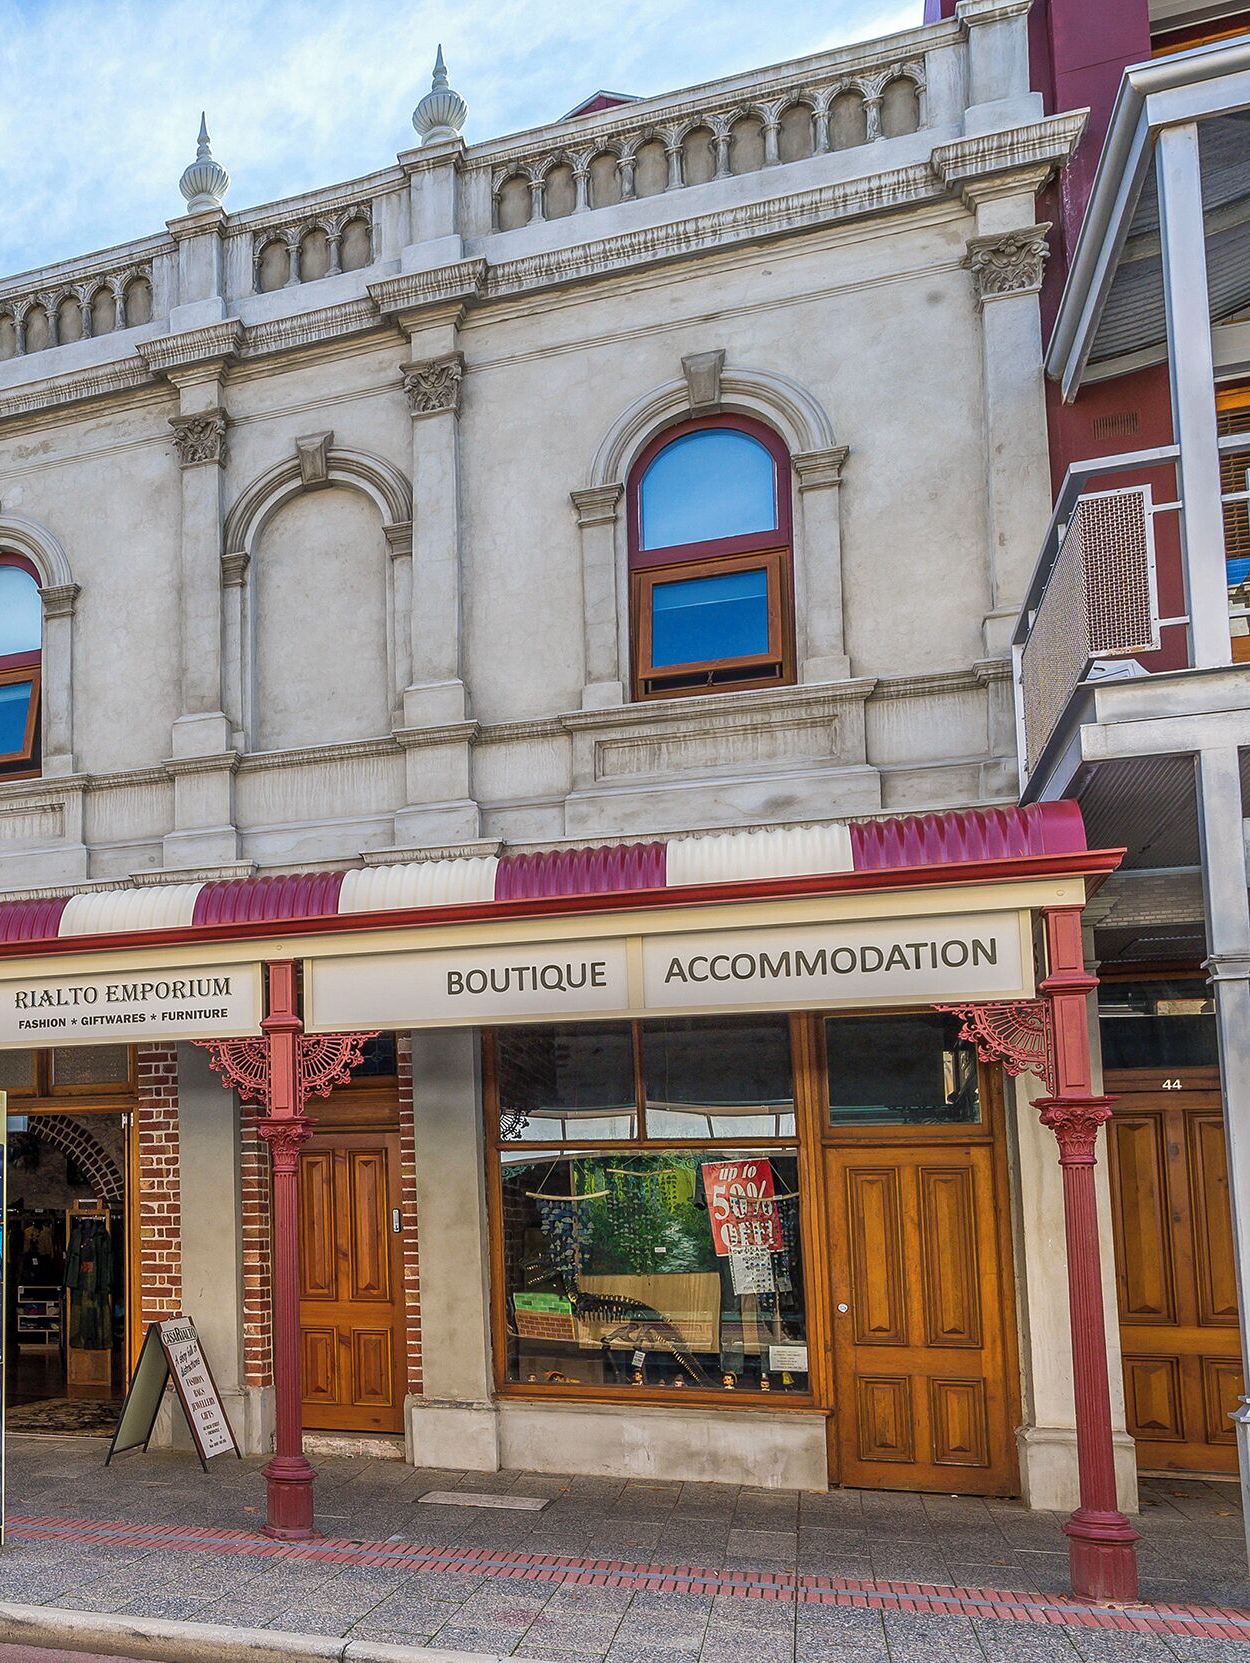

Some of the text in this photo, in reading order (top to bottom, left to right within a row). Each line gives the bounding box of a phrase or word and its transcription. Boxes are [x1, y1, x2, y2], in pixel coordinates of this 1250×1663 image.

[447, 938, 998, 995] BOUTIQUE ACCOMMODATION
[15, 977, 233, 1010] RIALTO EMPORIUM
[18, 1008, 228, 1030] FASHION GIFTWARES FURNITURE
[1162, 1079, 1182, 1090] 44
[718, 1164, 757, 1182] up to
[712, 1180, 773, 1220] 50%
[720, 1220, 773, 1247] OFF!
